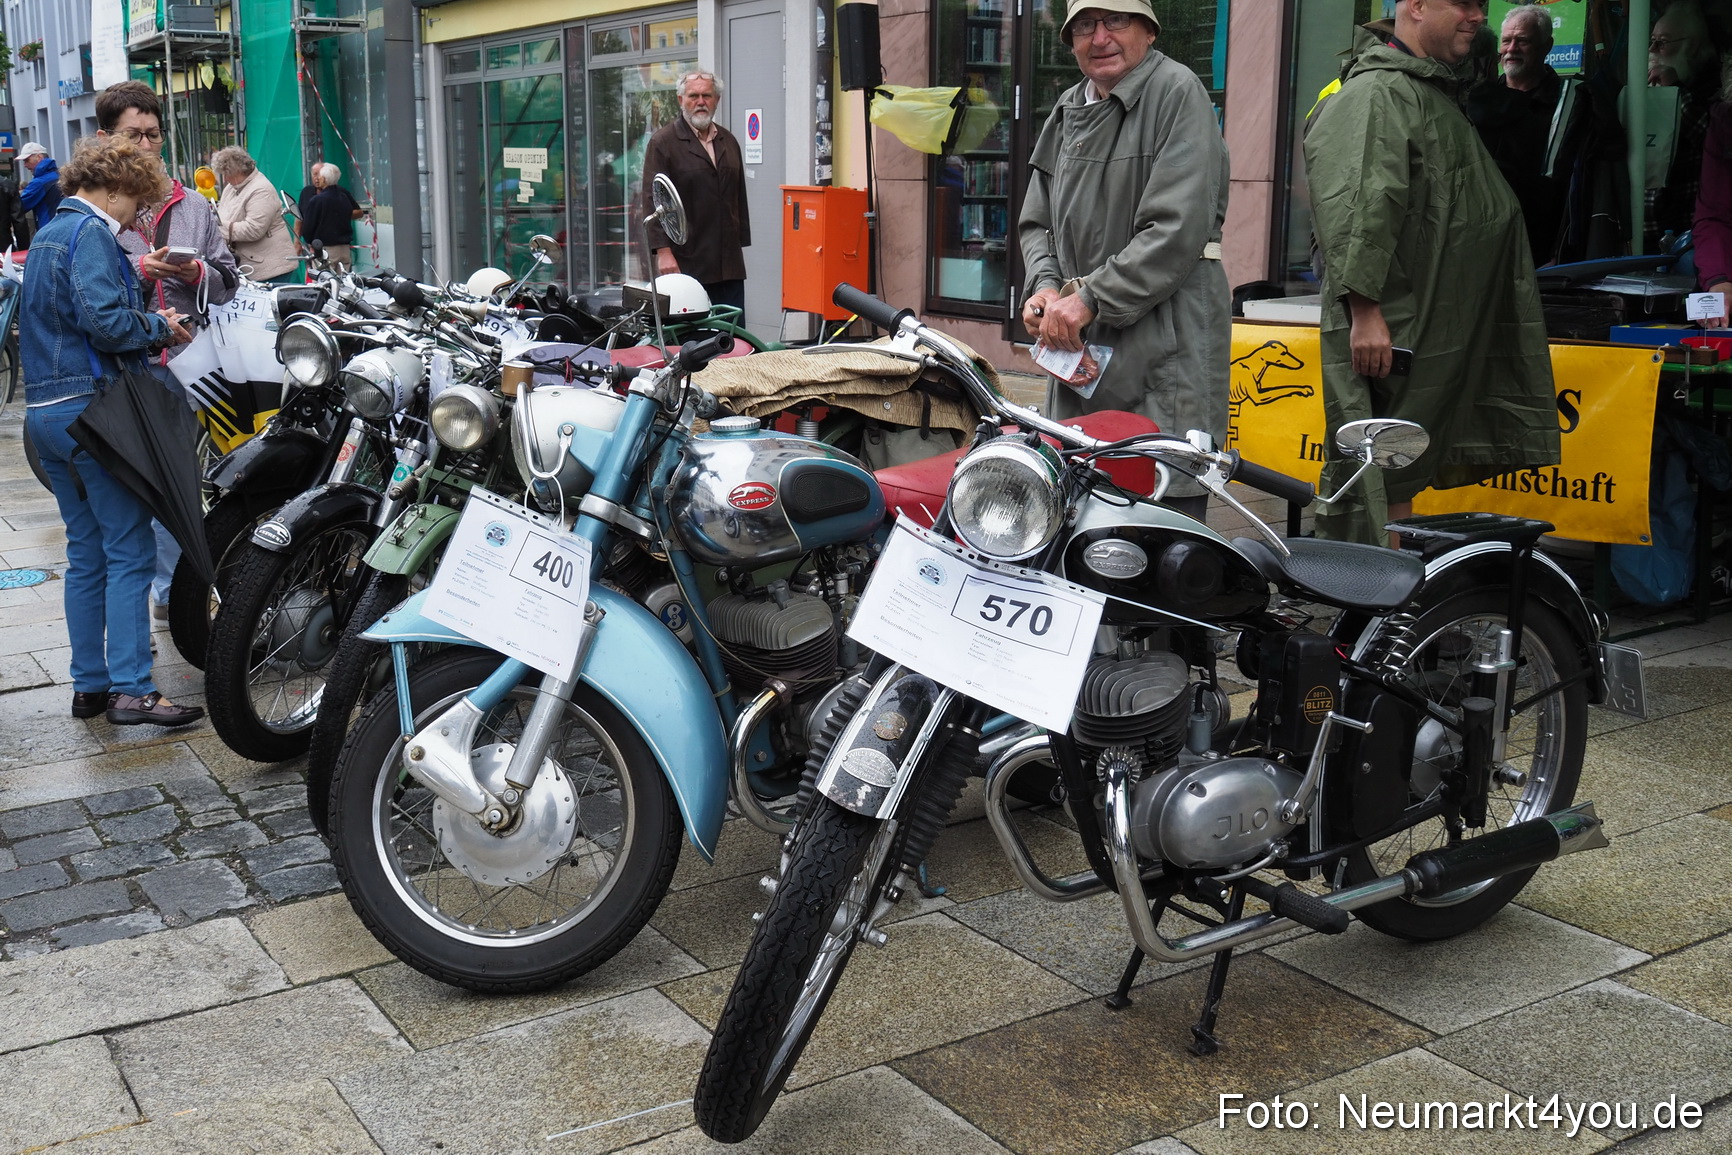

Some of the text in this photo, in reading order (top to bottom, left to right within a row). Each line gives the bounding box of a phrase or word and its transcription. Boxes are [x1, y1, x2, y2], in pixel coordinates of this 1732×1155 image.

[230, 297, 256, 312] 514
[735, 496, 770, 507] EXPRESS
[532, 550, 574, 589] 400
[979, 593, 1054, 636] 570
[1306, 700, 1331, 710] BLITZ
